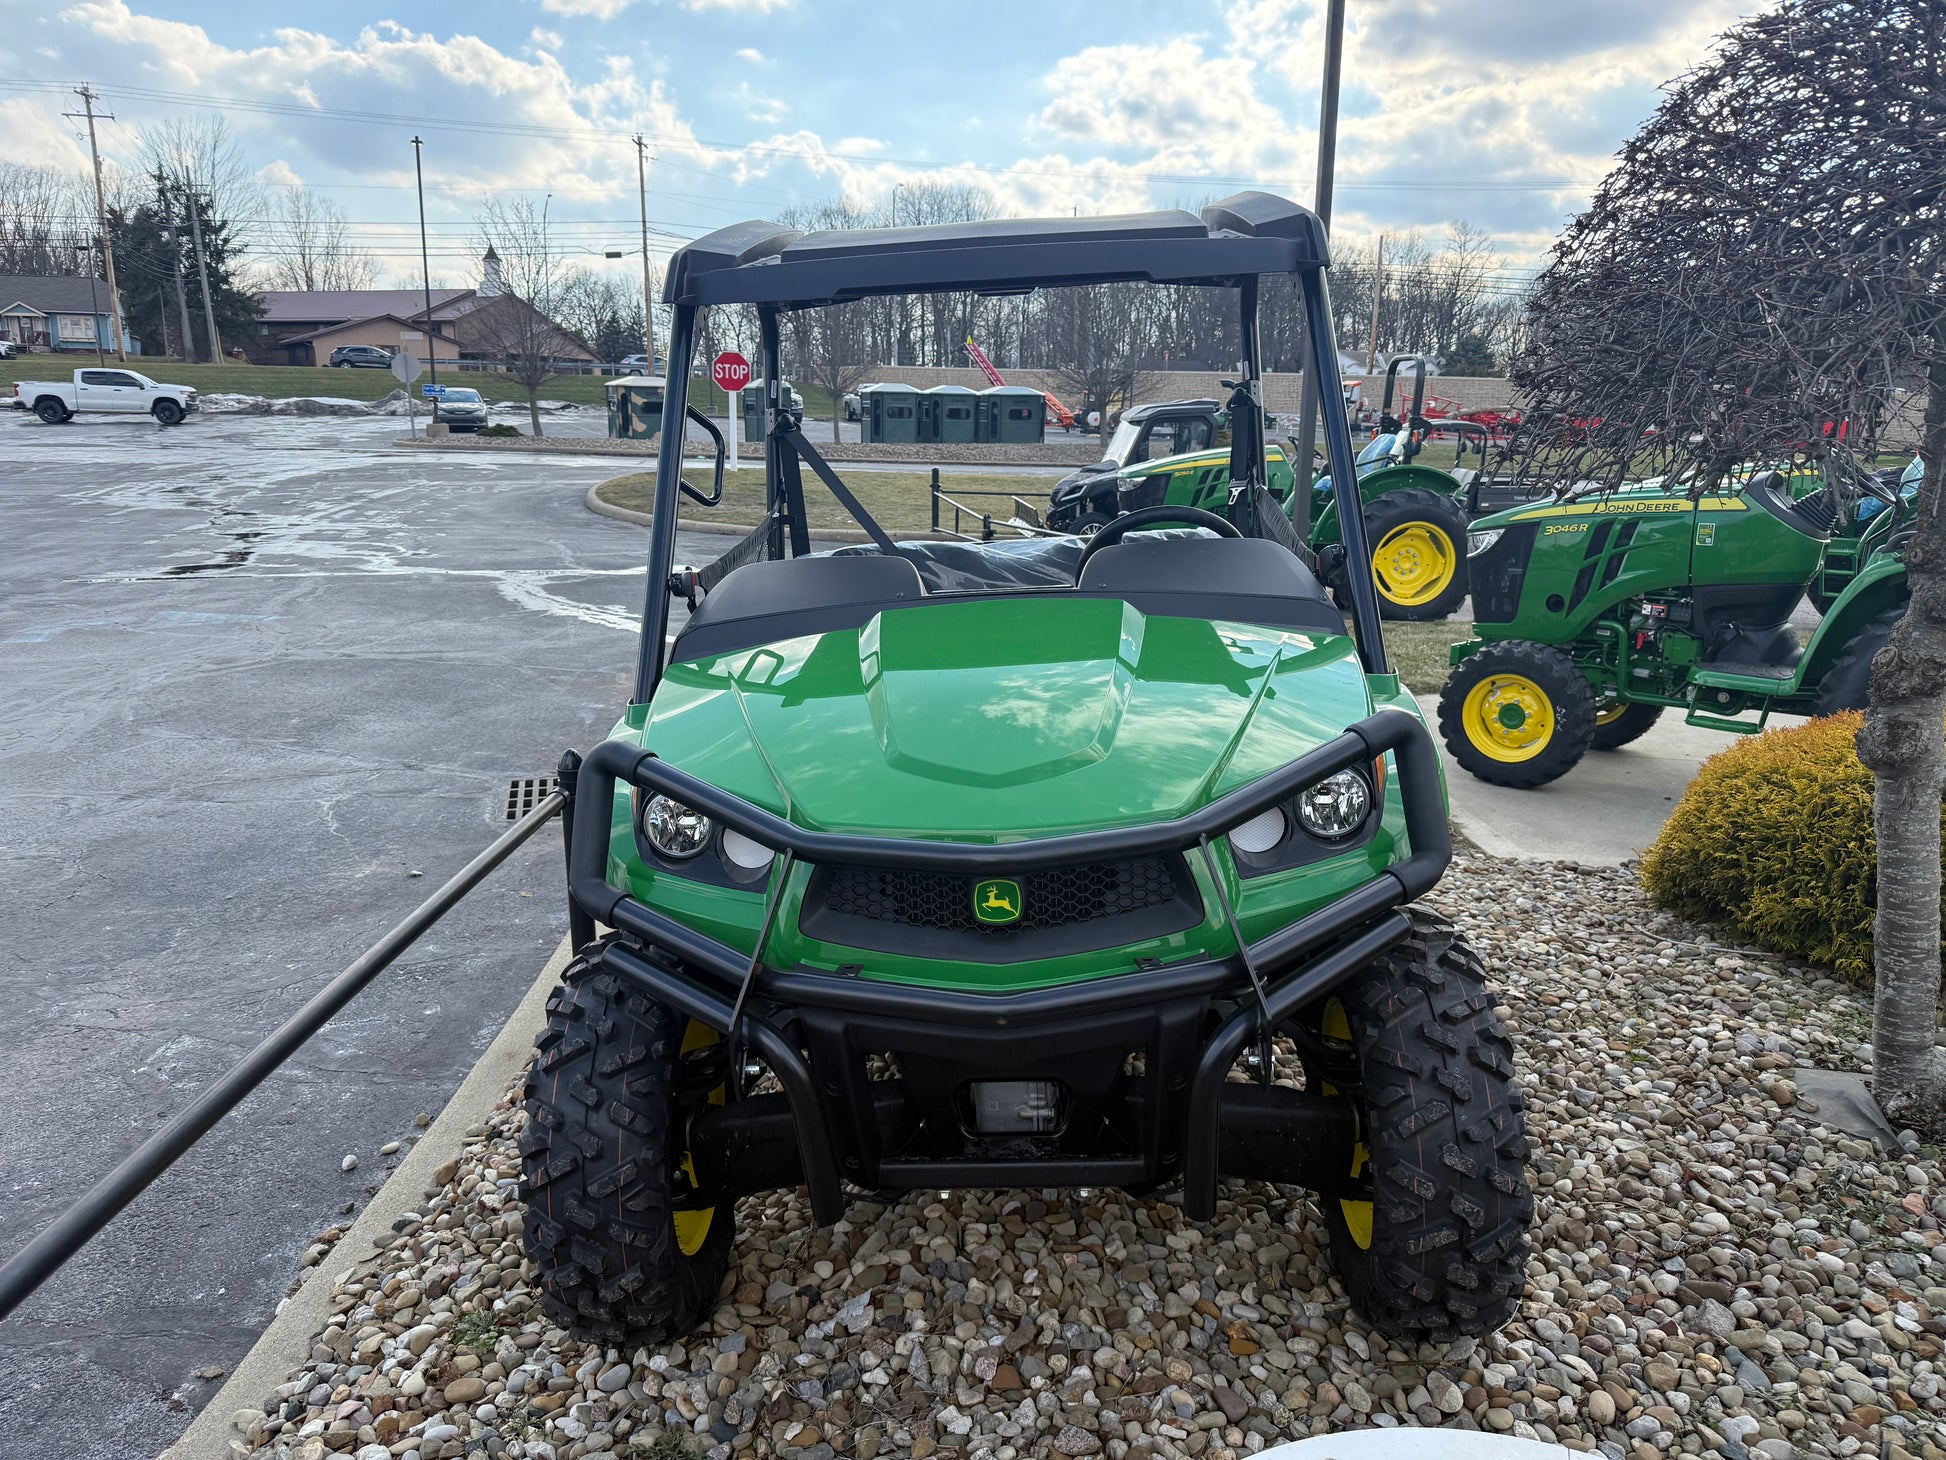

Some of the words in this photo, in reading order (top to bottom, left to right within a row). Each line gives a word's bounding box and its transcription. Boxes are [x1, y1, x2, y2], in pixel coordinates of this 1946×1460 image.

[715, 363, 749, 380] STOP
[1599, 502, 1634, 513] JOHN
[1636, 502, 1680, 512] DEERE
